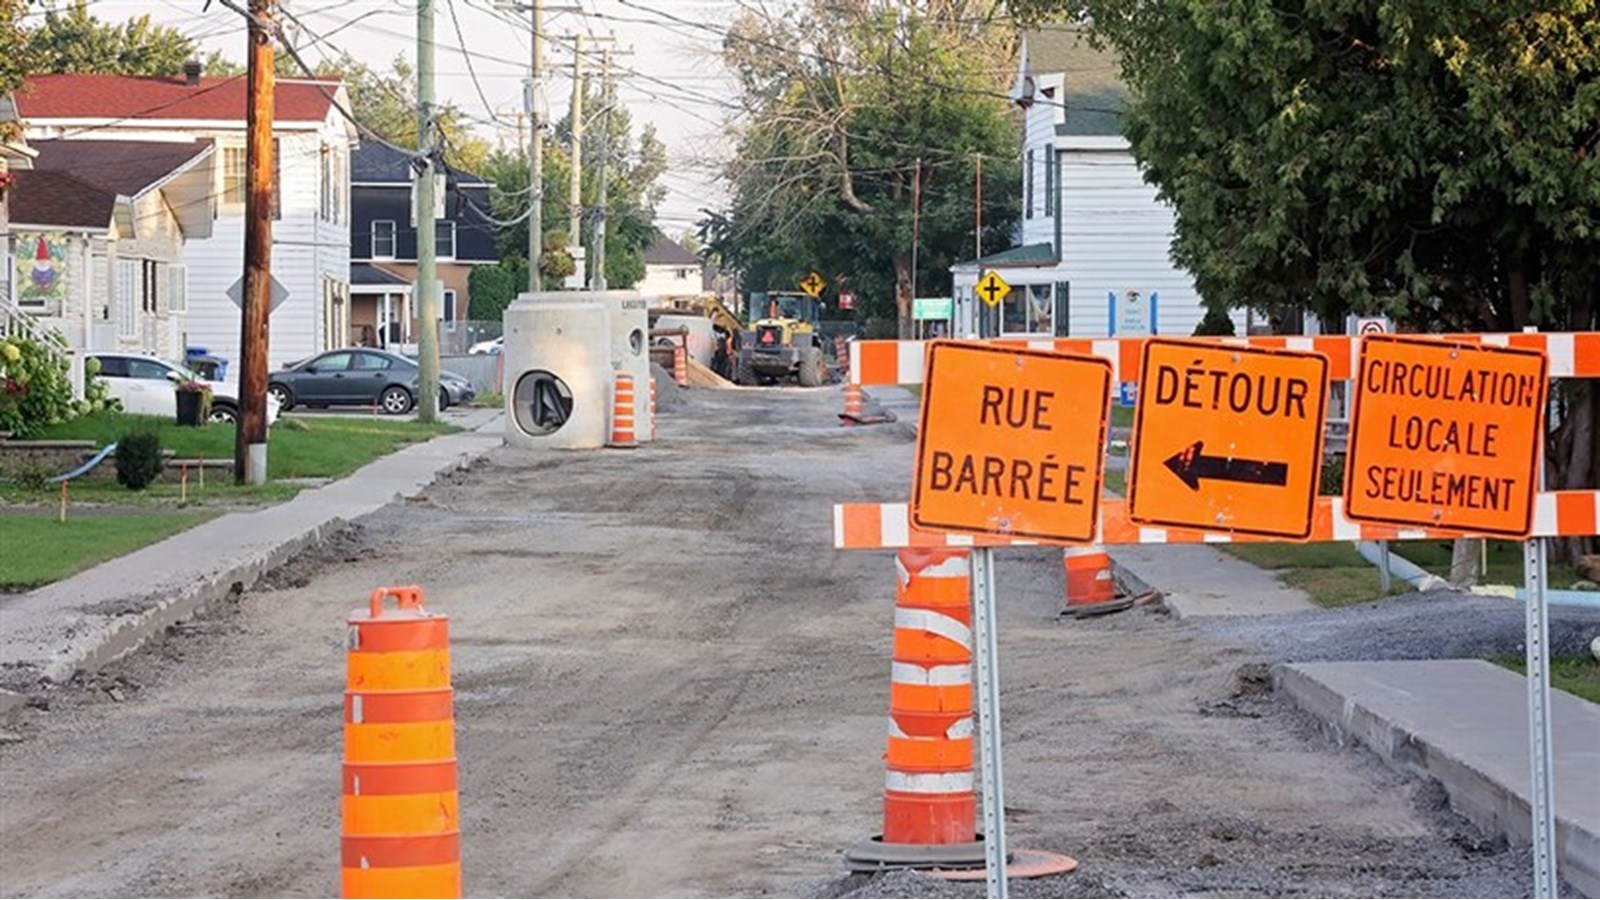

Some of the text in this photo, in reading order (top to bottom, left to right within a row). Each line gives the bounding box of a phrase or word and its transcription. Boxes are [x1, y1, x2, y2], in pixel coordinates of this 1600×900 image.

[1155, 359, 1308, 419] DÉTOUR
[1367, 359, 1535, 408] CIRCULATION
[981, 385, 1055, 431] RUE
[1388, 415, 1499, 457] LOCALE
[930, 451, 1085, 505] BARRÉE
[1365, 465, 1516, 512] SEULEMENT
